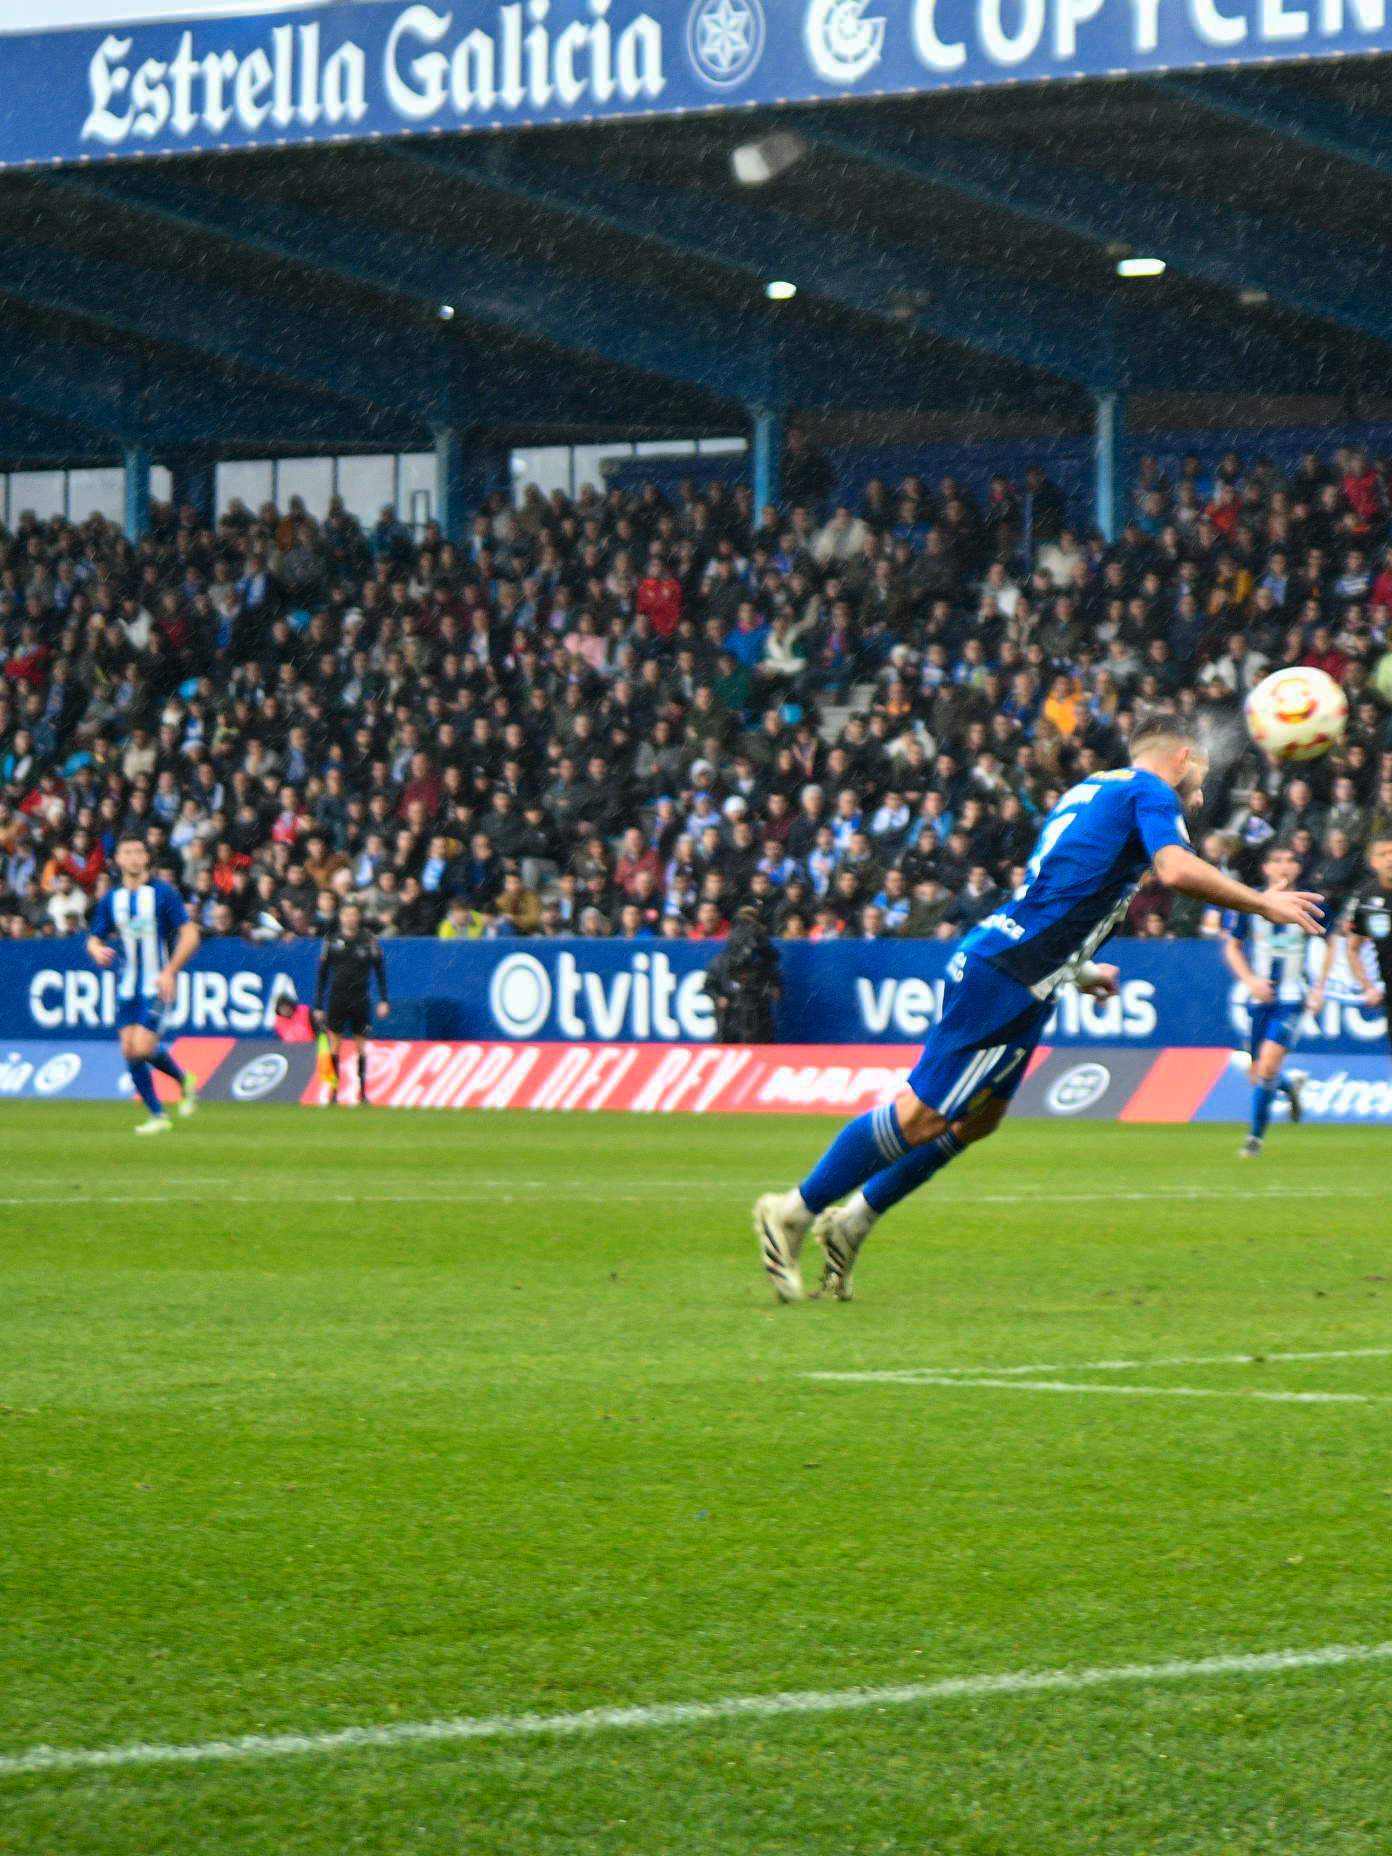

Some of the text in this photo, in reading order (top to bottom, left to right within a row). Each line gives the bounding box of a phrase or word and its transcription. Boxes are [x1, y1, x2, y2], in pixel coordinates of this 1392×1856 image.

[80, 0, 667, 144] Estrella Galicia
[28, 968, 302, 1031] CRIURSA
[388, 1044, 540, 1107] COPA
[760, 1065, 918, 1105] MAPF
